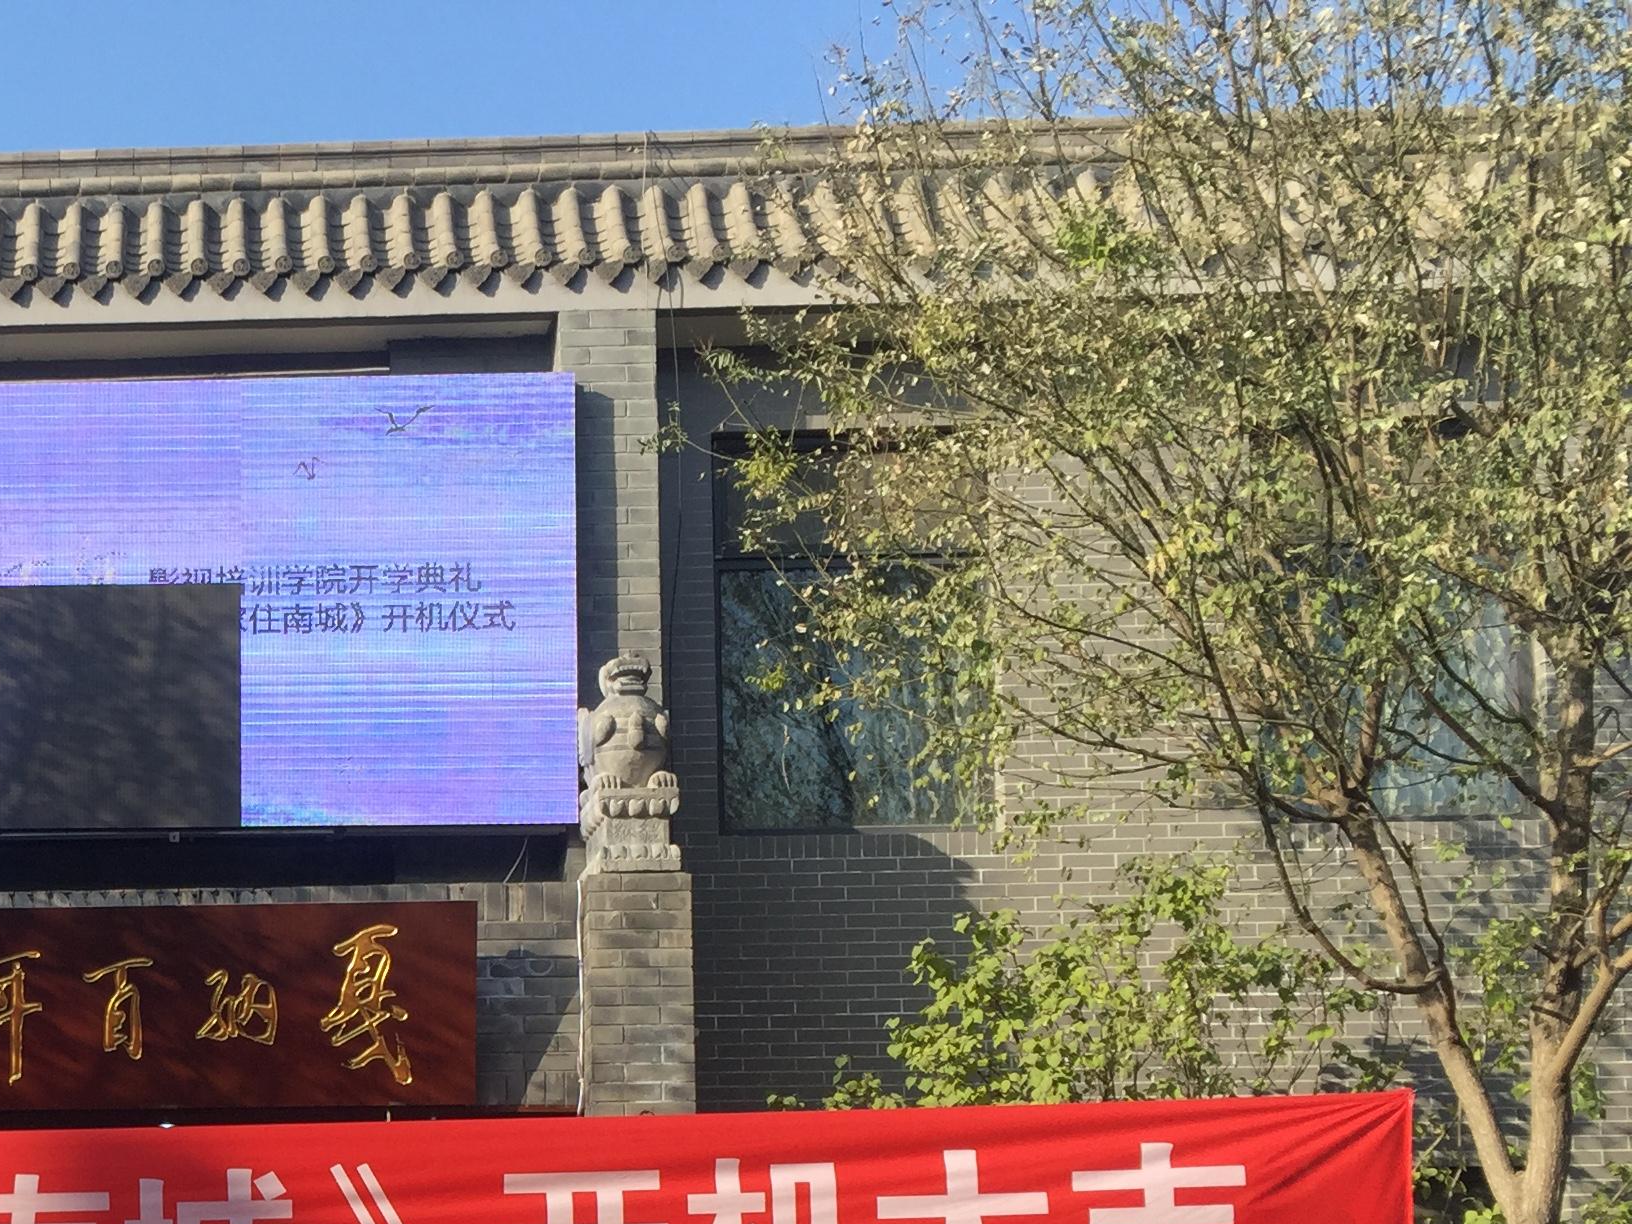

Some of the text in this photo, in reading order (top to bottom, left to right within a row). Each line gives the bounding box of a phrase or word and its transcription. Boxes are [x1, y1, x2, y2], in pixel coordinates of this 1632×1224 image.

[240, 600, 517, 635] 住南城》开机仪式
